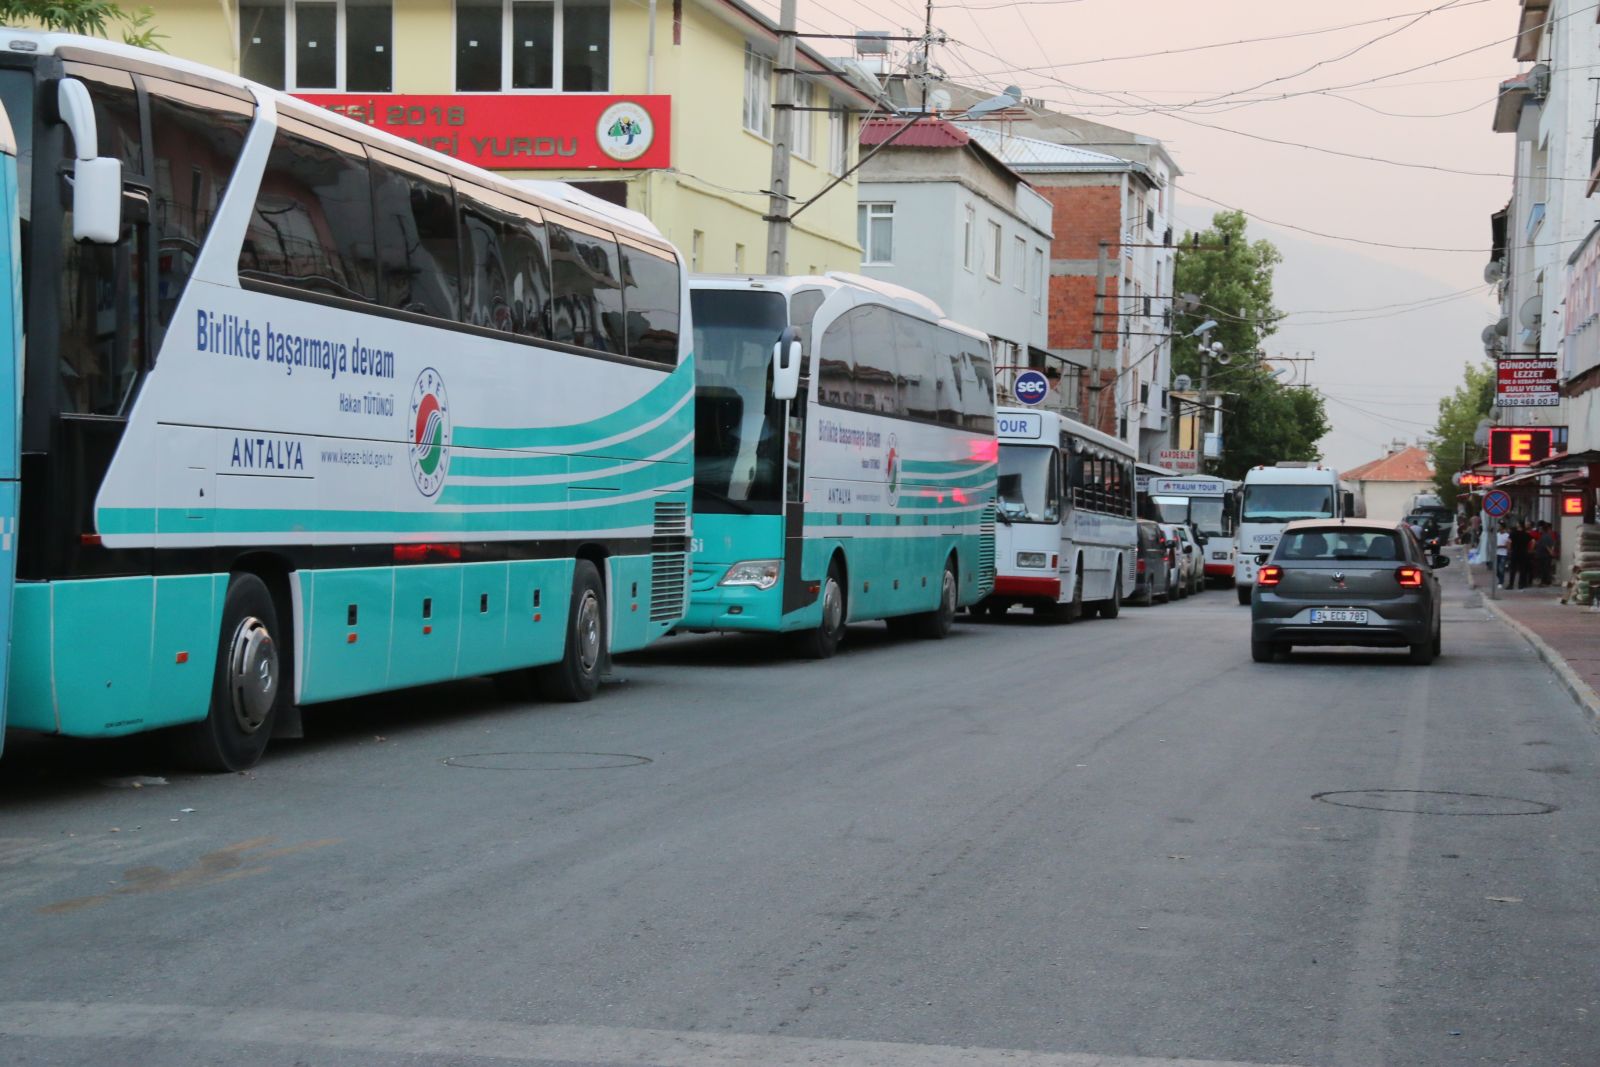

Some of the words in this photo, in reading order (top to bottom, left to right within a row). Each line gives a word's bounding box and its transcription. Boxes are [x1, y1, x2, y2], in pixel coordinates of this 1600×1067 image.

[386, 105, 466, 125] 2018
[471, 136, 577, 157] YURDU
[197, 309, 261, 360] Birlikte
[266, 322, 347, 379] başarmaya
[352, 338, 395, 378] devam
[1513, 370, 1544, 378] LEZZET
[1017, 381, 1044, 393] seç
[339, 393, 362, 414] Hakan
[363, 391, 394, 417] TÜTÜNCÜ
[231, 437, 304, 470] ANTALYA
[321, 450, 393, 468] www.kepez-bld.gov.tr
[1511, 434, 1531, 461] E
[1172, 483, 1196, 491] TRAUM
[1199, 483, 1217, 491] TOUR
[1565, 498, 1582, 513] E
[1317, 611, 1327, 620] 34
[1331, 611, 1346, 620] ECG
